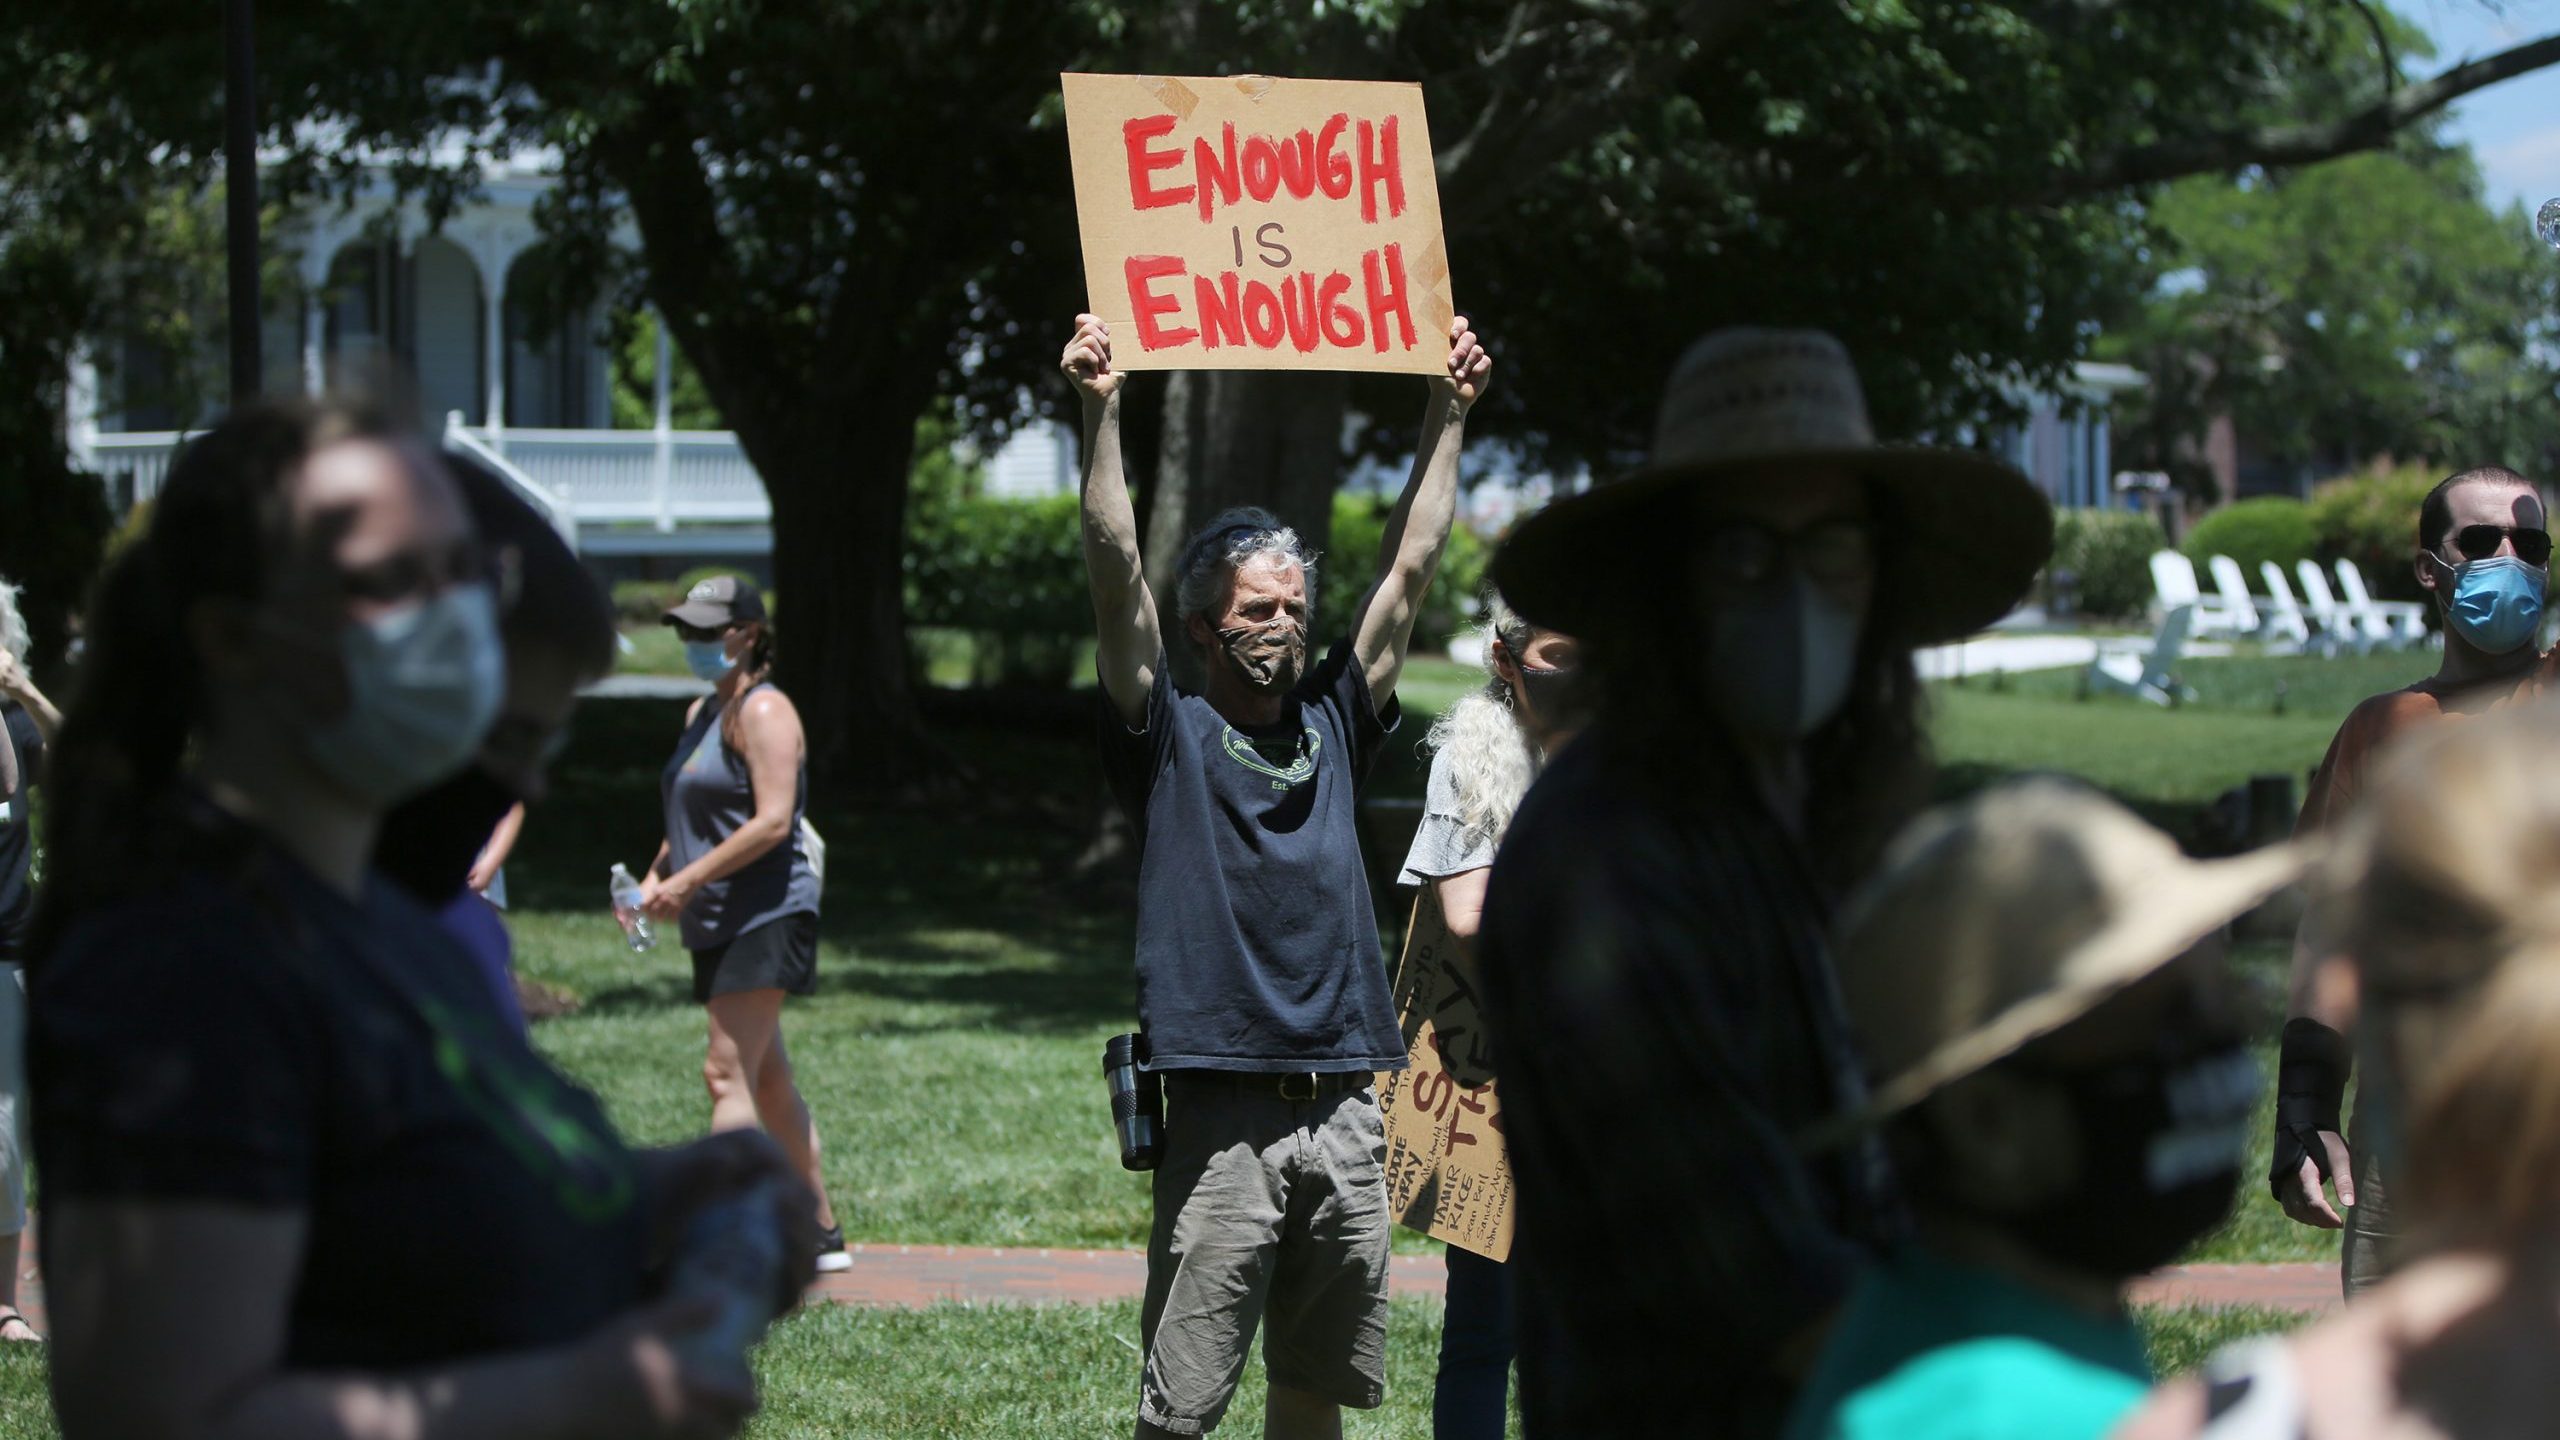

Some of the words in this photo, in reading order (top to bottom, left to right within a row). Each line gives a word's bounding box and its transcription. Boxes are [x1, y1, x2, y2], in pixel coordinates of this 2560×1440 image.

[1123, 112, 1406, 224] ENOUGH
[1232, 222, 1292, 268] IS
[1124, 241, 1418, 354] ENOUGH
[1411, 958, 1479, 1121] SAY
[1396, 1151, 1423, 1212] GRAY
[1431, 1164, 1461, 1229] TAMIR
[1446, 1171, 1472, 1231] RICE
[1462, 1209, 1478, 1243] Sean
[1472, 1172, 1489, 1202] Bell
[1475, 1194, 1495, 1240] Sandra
[1484, 1227, 1498, 1254] John
